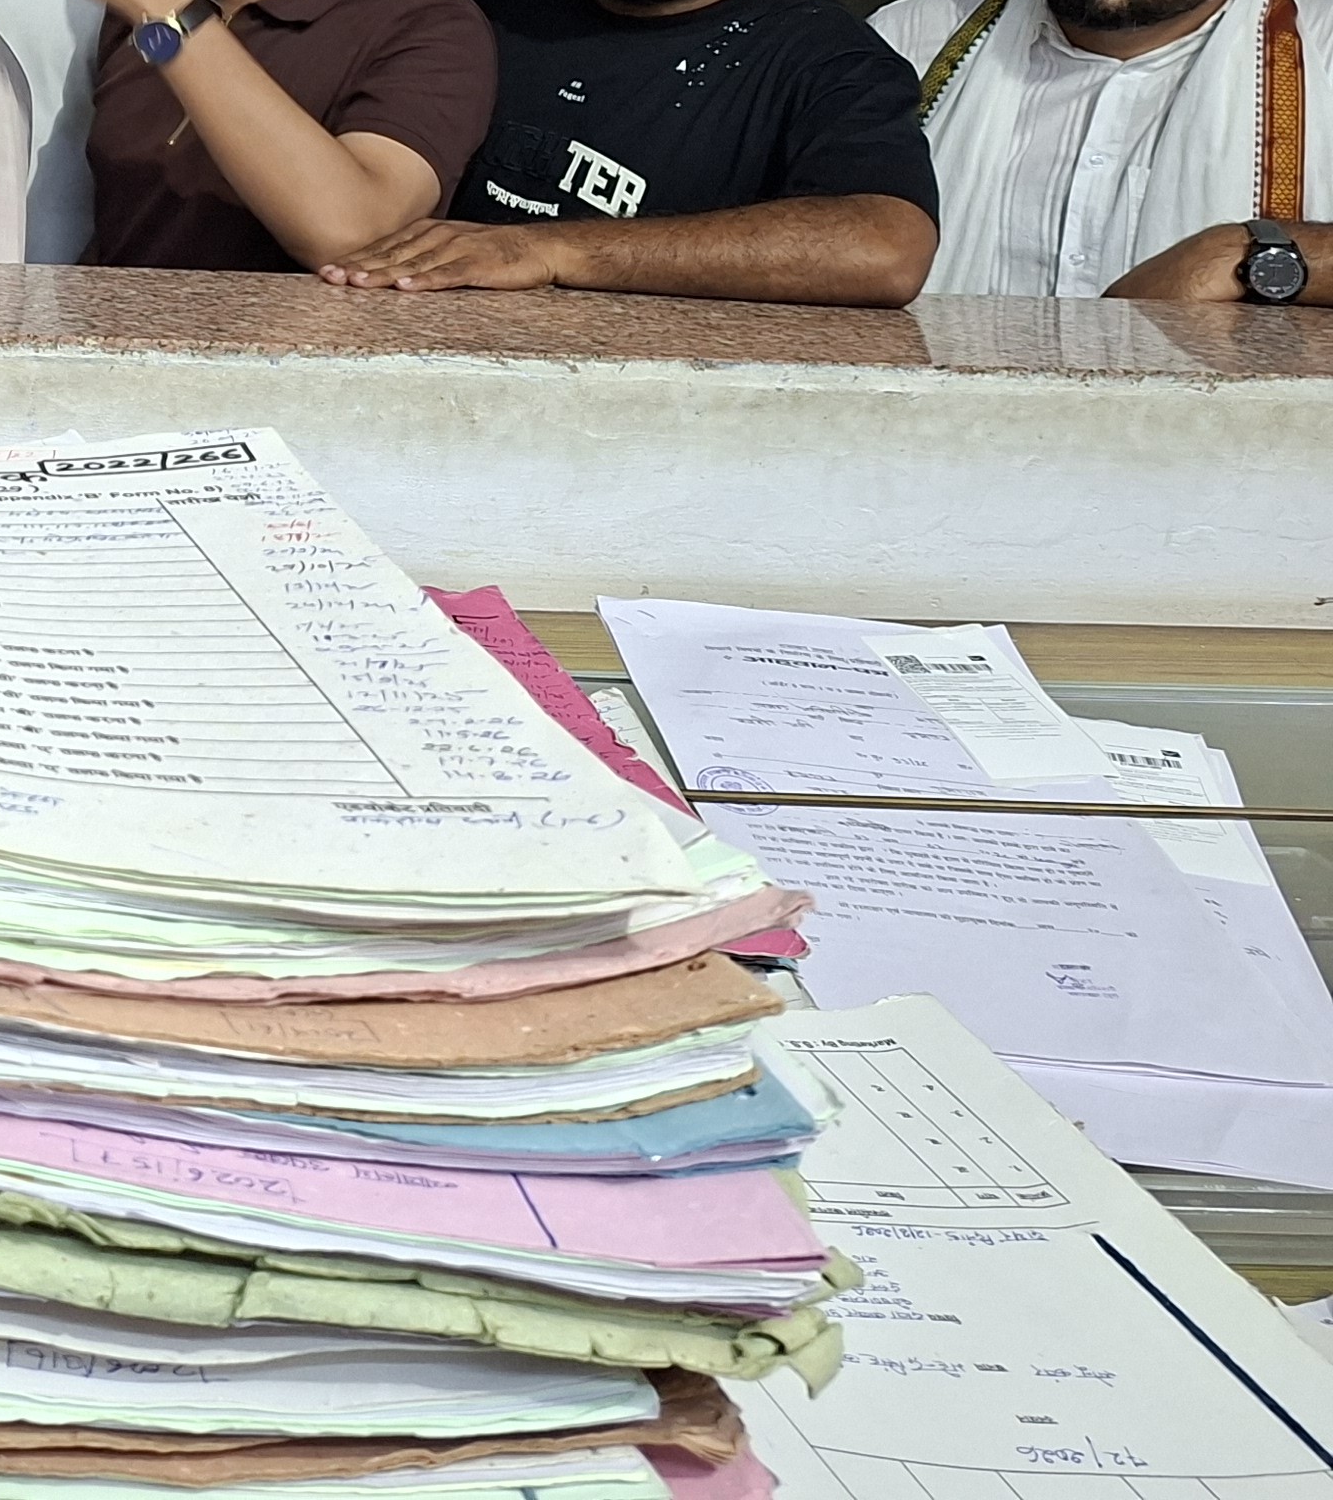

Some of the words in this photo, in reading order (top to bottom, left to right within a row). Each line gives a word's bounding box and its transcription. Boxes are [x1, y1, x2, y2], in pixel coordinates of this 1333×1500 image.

[55, 457, 159, 473] 2022
[172, 448, 243, 466] 266
[109, 490, 162, 499] Form
[165, 488, 202, 497] No.
